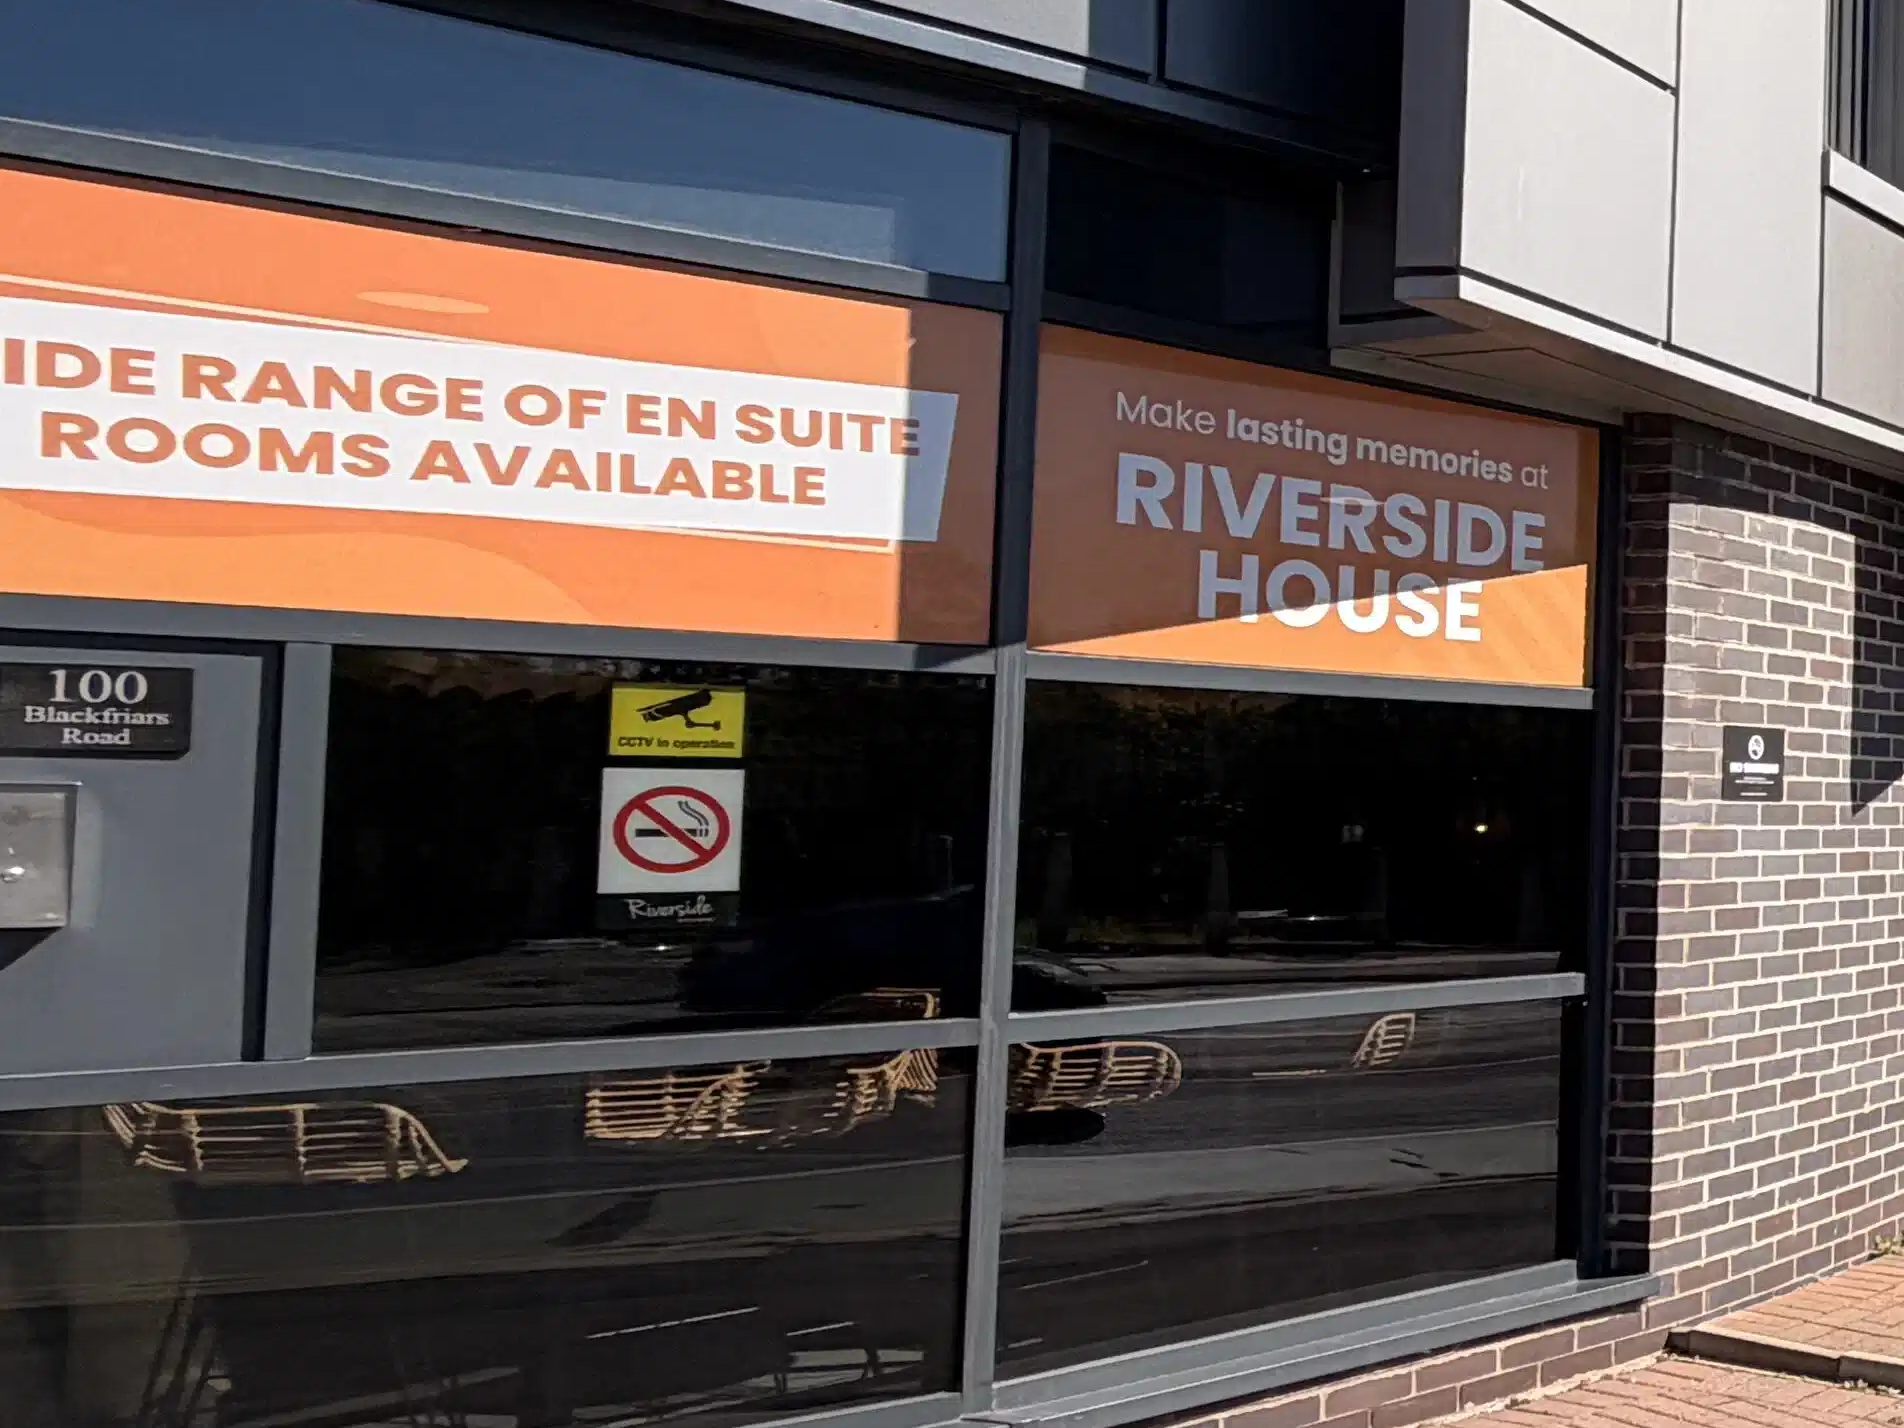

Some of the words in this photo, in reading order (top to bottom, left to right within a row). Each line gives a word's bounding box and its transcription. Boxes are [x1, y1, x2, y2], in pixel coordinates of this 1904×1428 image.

[4, 338, 156, 396] IDE
[182, 353, 484, 422] RANGE
[504, 384, 606, 429] OF
[627, 394, 716, 440] EN
[735, 403, 920, 456] SUITE
[41, 410, 391, 478] ROOMS
[410, 440, 826, 506] AVAILABLE
[1116, 391, 1216, 435] Make
[1227, 408, 1348, 466] lasting
[1356, 436, 1513, 483] memories
[1521, 464, 1549, 490] at
[1116, 452, 1546, 572] RIVERSIDE
[1198, 549, 1483, 642] HOUSE
[24, 705, 171, 725] Blackfriars
[49, 669, 148, 704] 100
[61, 728, 131, 745] Road
[617, 736, 654, 747] CCTV
[657, 737, 669, 748] in
[624, 894, 713, 920] Riverside
